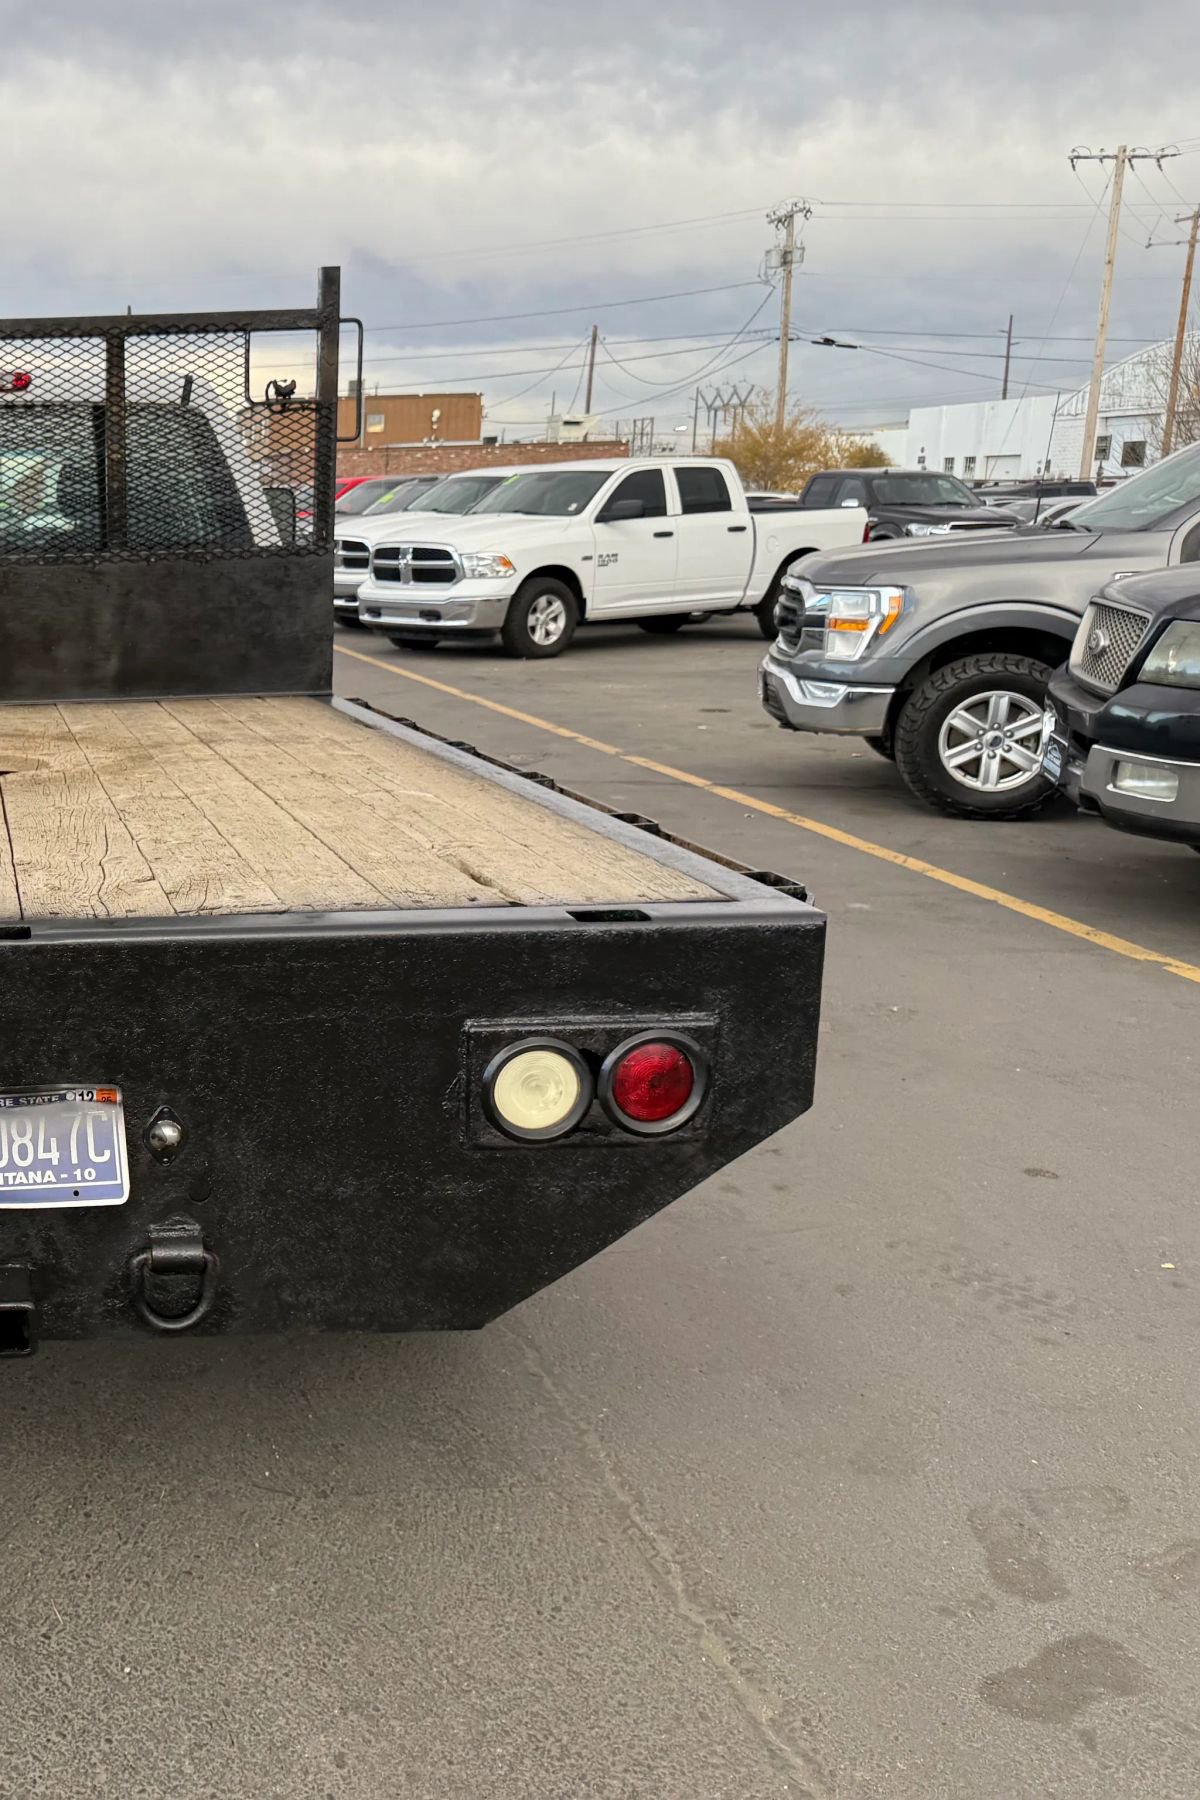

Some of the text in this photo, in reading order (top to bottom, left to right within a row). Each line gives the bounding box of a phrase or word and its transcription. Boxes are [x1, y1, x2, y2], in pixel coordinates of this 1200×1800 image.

[19, 1095, 60, 1105] STATE
[78, 1090, 94, 1102] 12
[73, 1167, 97, 1181] 10
